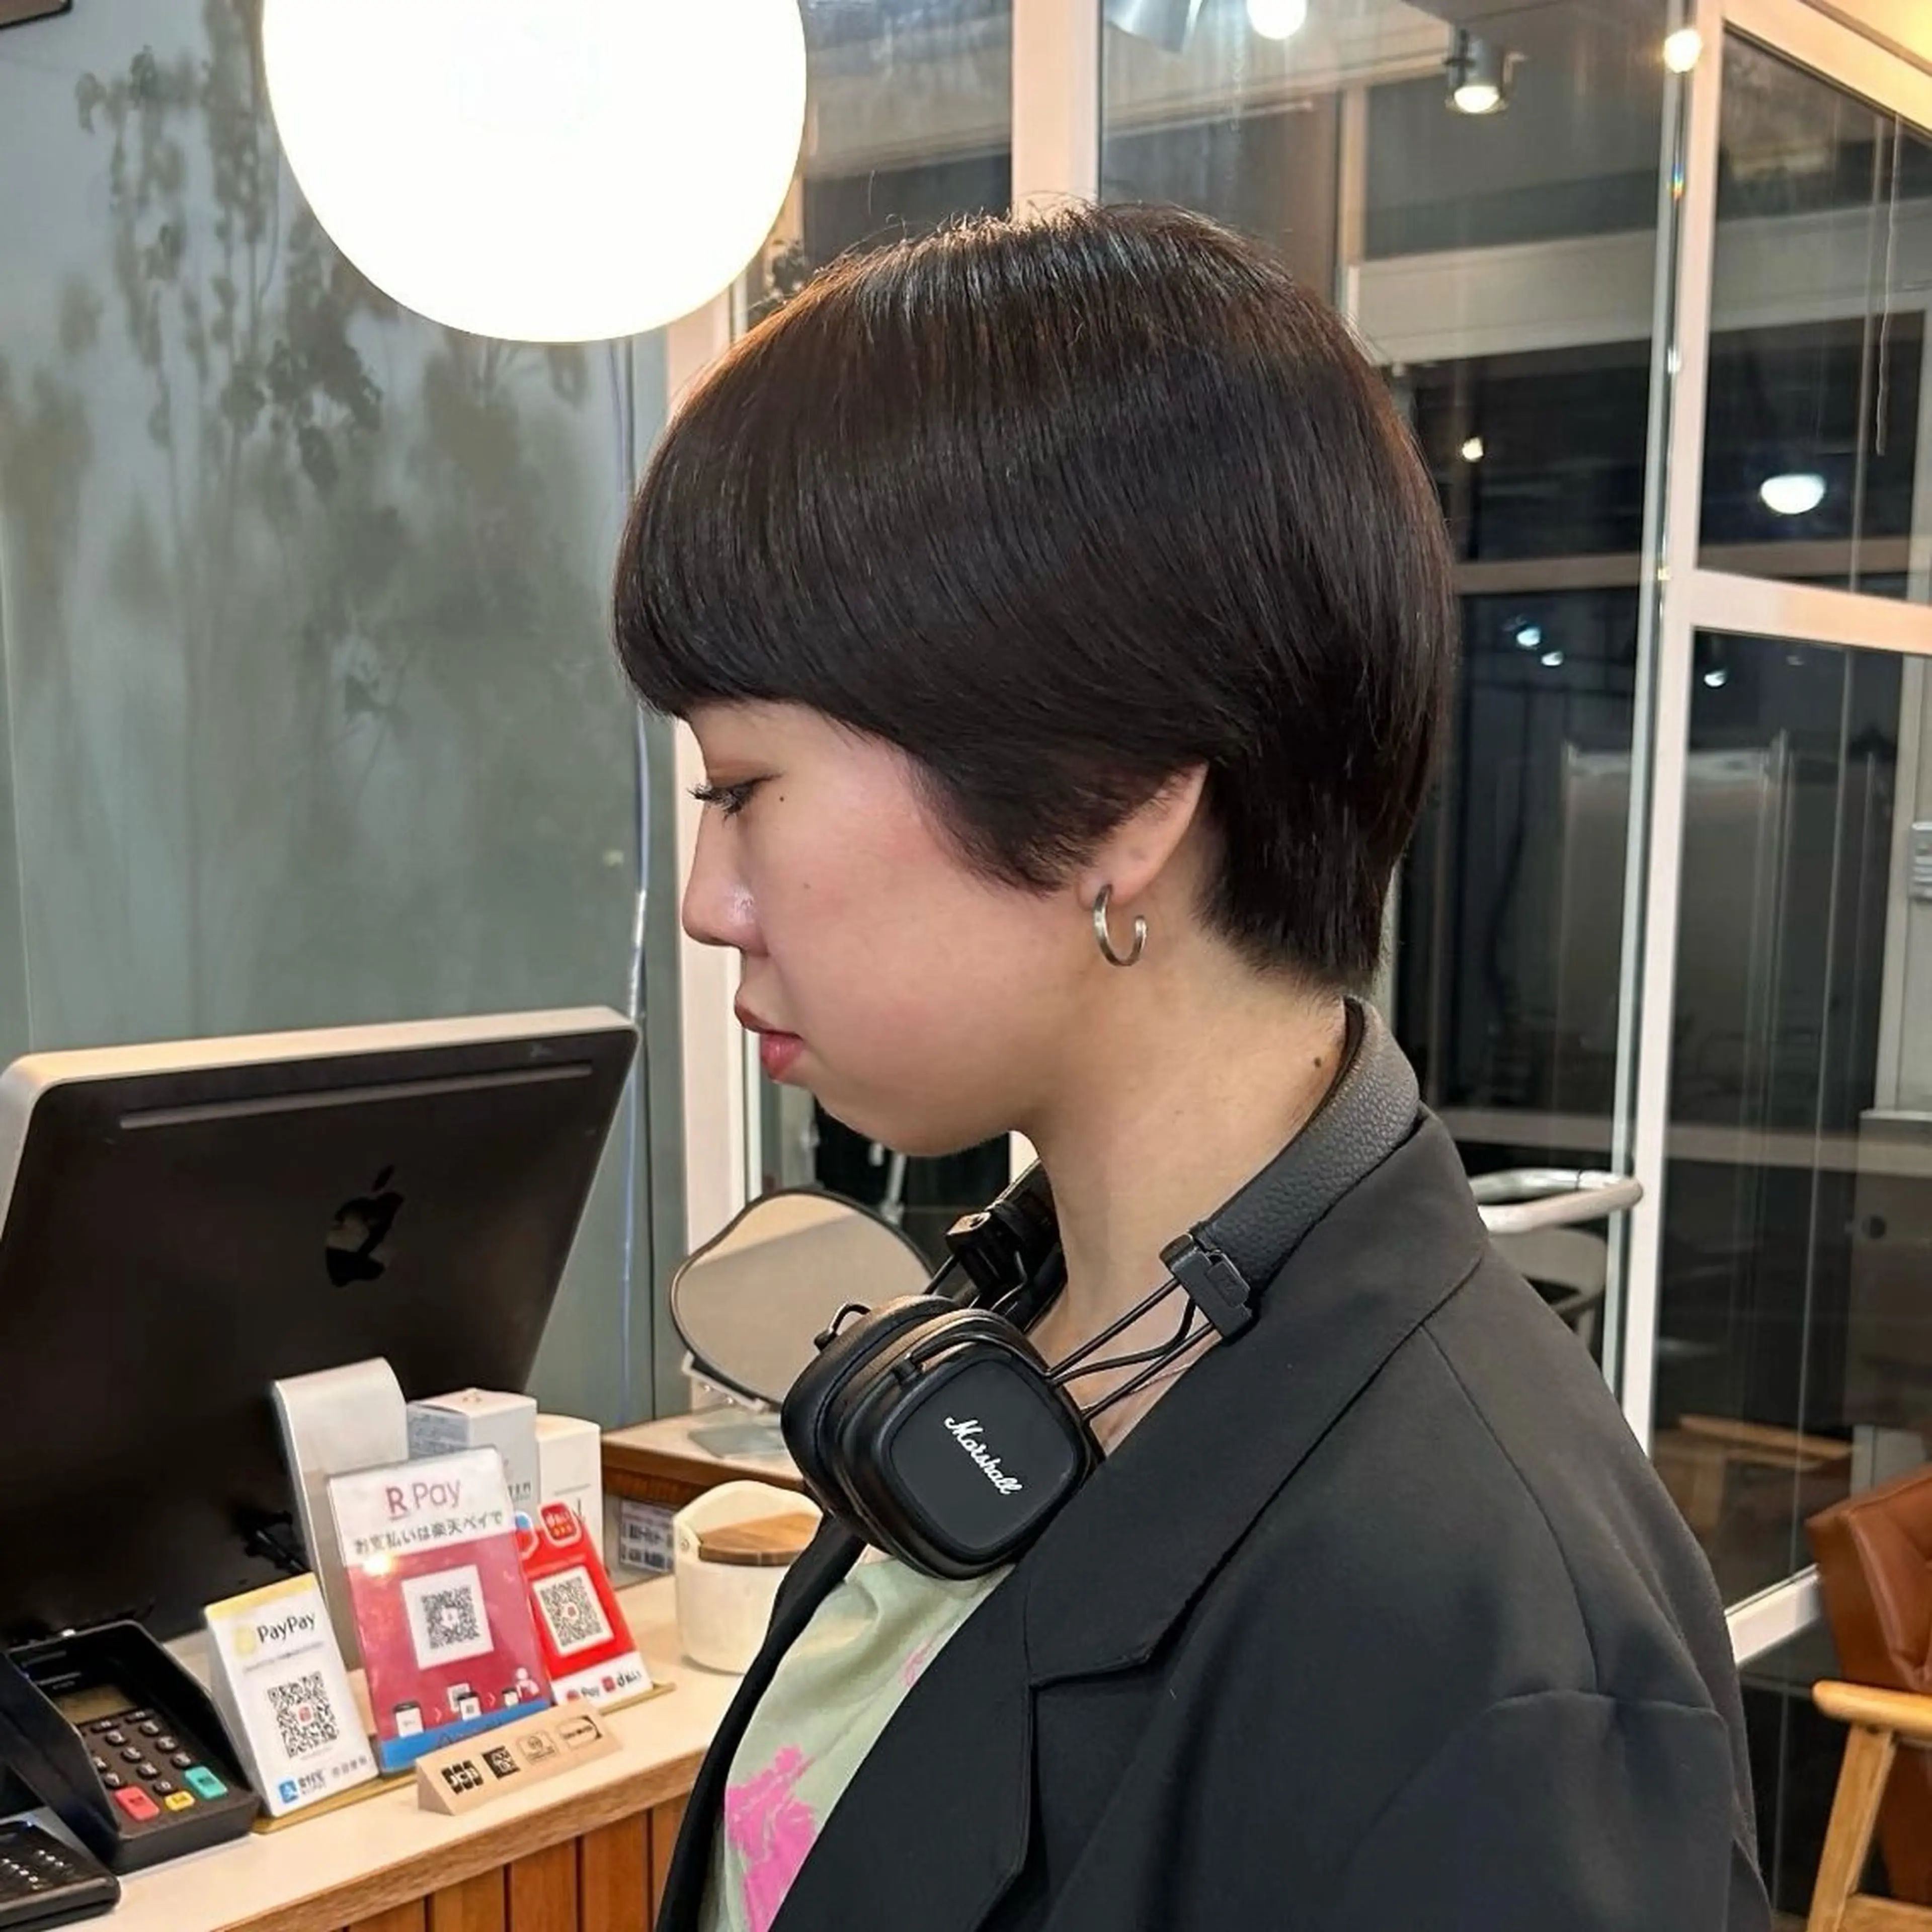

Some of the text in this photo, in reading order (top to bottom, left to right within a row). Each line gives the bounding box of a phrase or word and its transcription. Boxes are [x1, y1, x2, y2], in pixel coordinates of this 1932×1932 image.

[944, 1417, 1023, 1495] Marshall
[412, 1480, 461, 1510] Pay
[257, 1612, 315, 1644] PayPay
